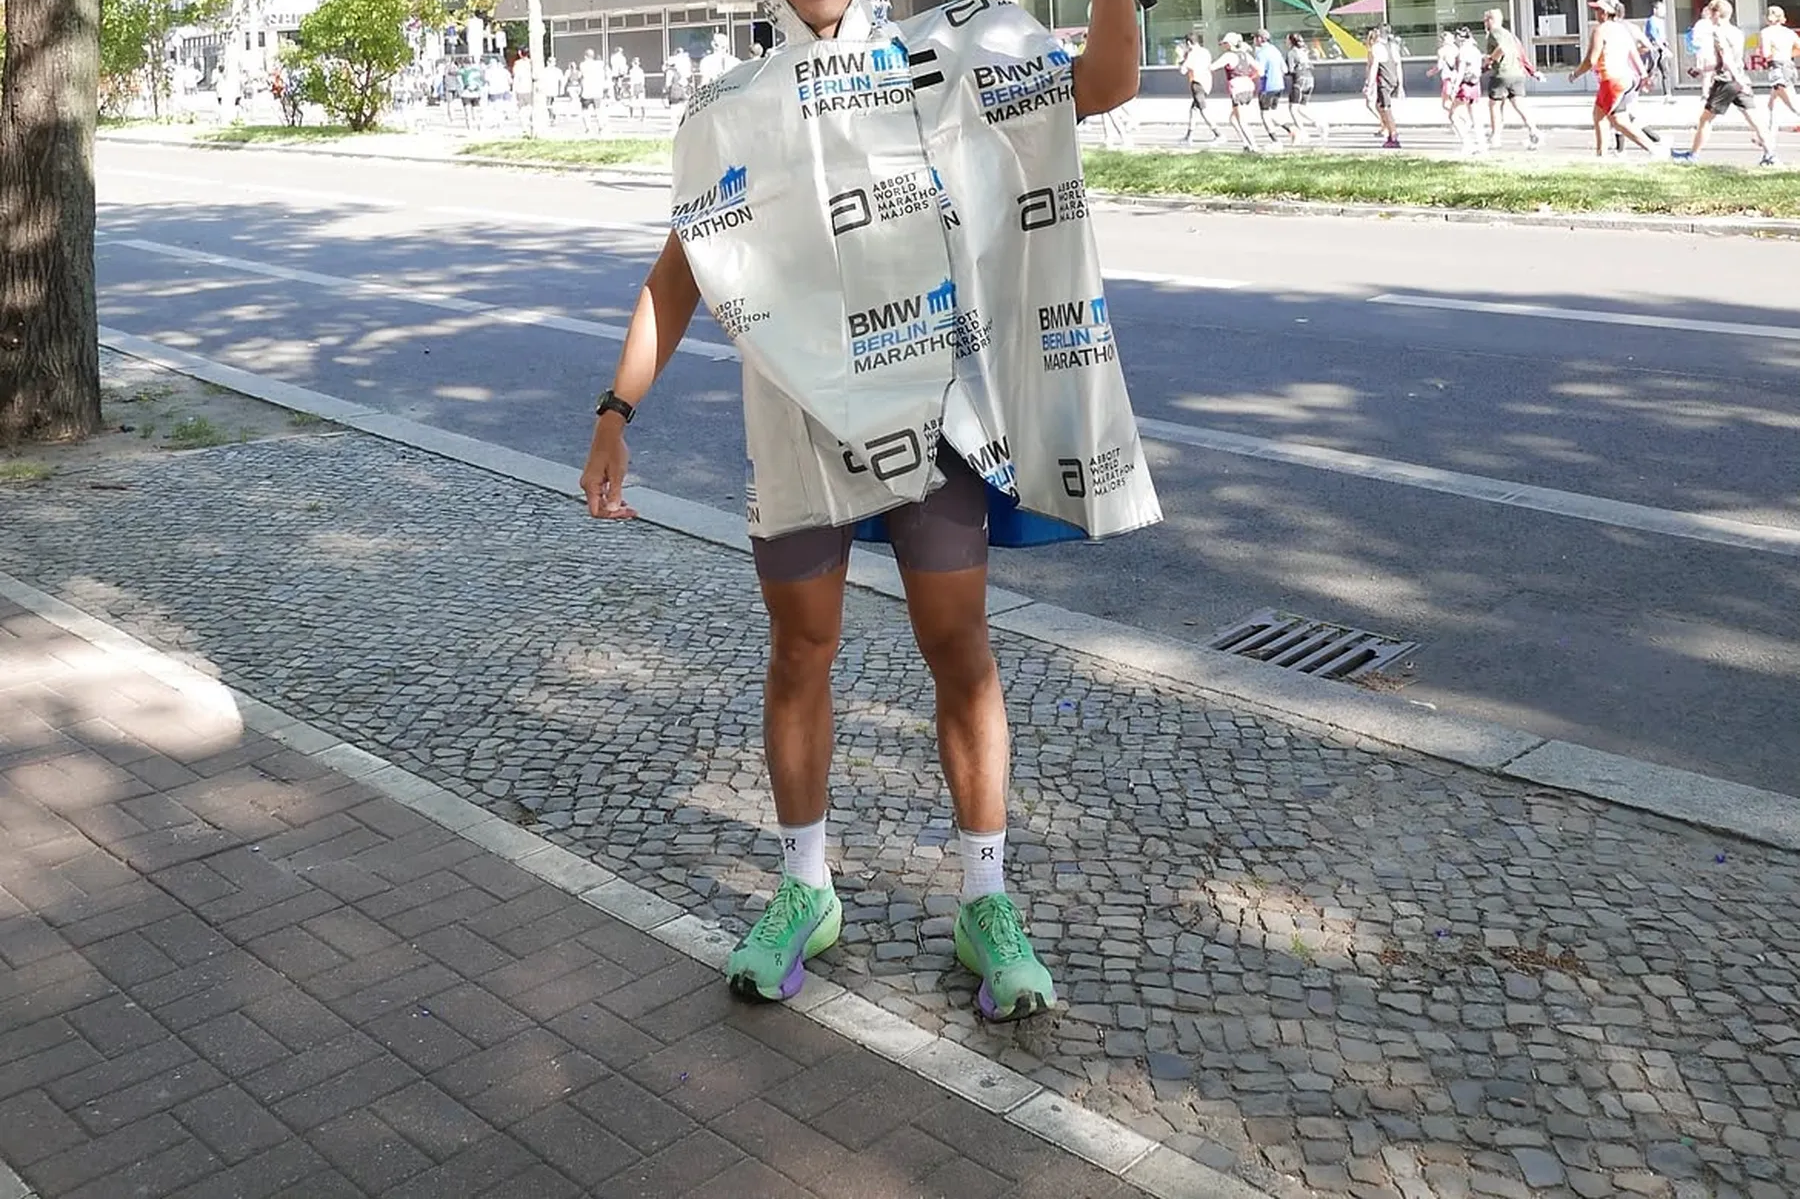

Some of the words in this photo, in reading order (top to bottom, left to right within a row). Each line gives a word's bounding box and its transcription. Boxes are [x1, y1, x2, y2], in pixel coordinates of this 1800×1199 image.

[795, 52, 865, 84] BMW
[974, 56, 1045, 89] BMW
[798, 75, 873, 102] BERLIN
[980, 72, 1054, 108] BERLIN
[985, 84, 1074, 124] MARATH
[873, 172, 918, 193] ABBOTT
[873, 183, 917, 202] WORLD
[878, 187, 938, 212] MARATHO
[880, 199, 930, 222] MAJORS
[681, 206, 753, 242] RATHON
[848, 295, 922, 339] BMW
[1039, 301, 1084, 330] BMW
[852, 320, 928, 357] BERLIN
[854, 329, 957, 374] MARATHO
[1042, 328, 1091, 351] BERLIN
[1044, 343, 1114, 371] MARATHO
[967, 435, 1010, 473] MW
